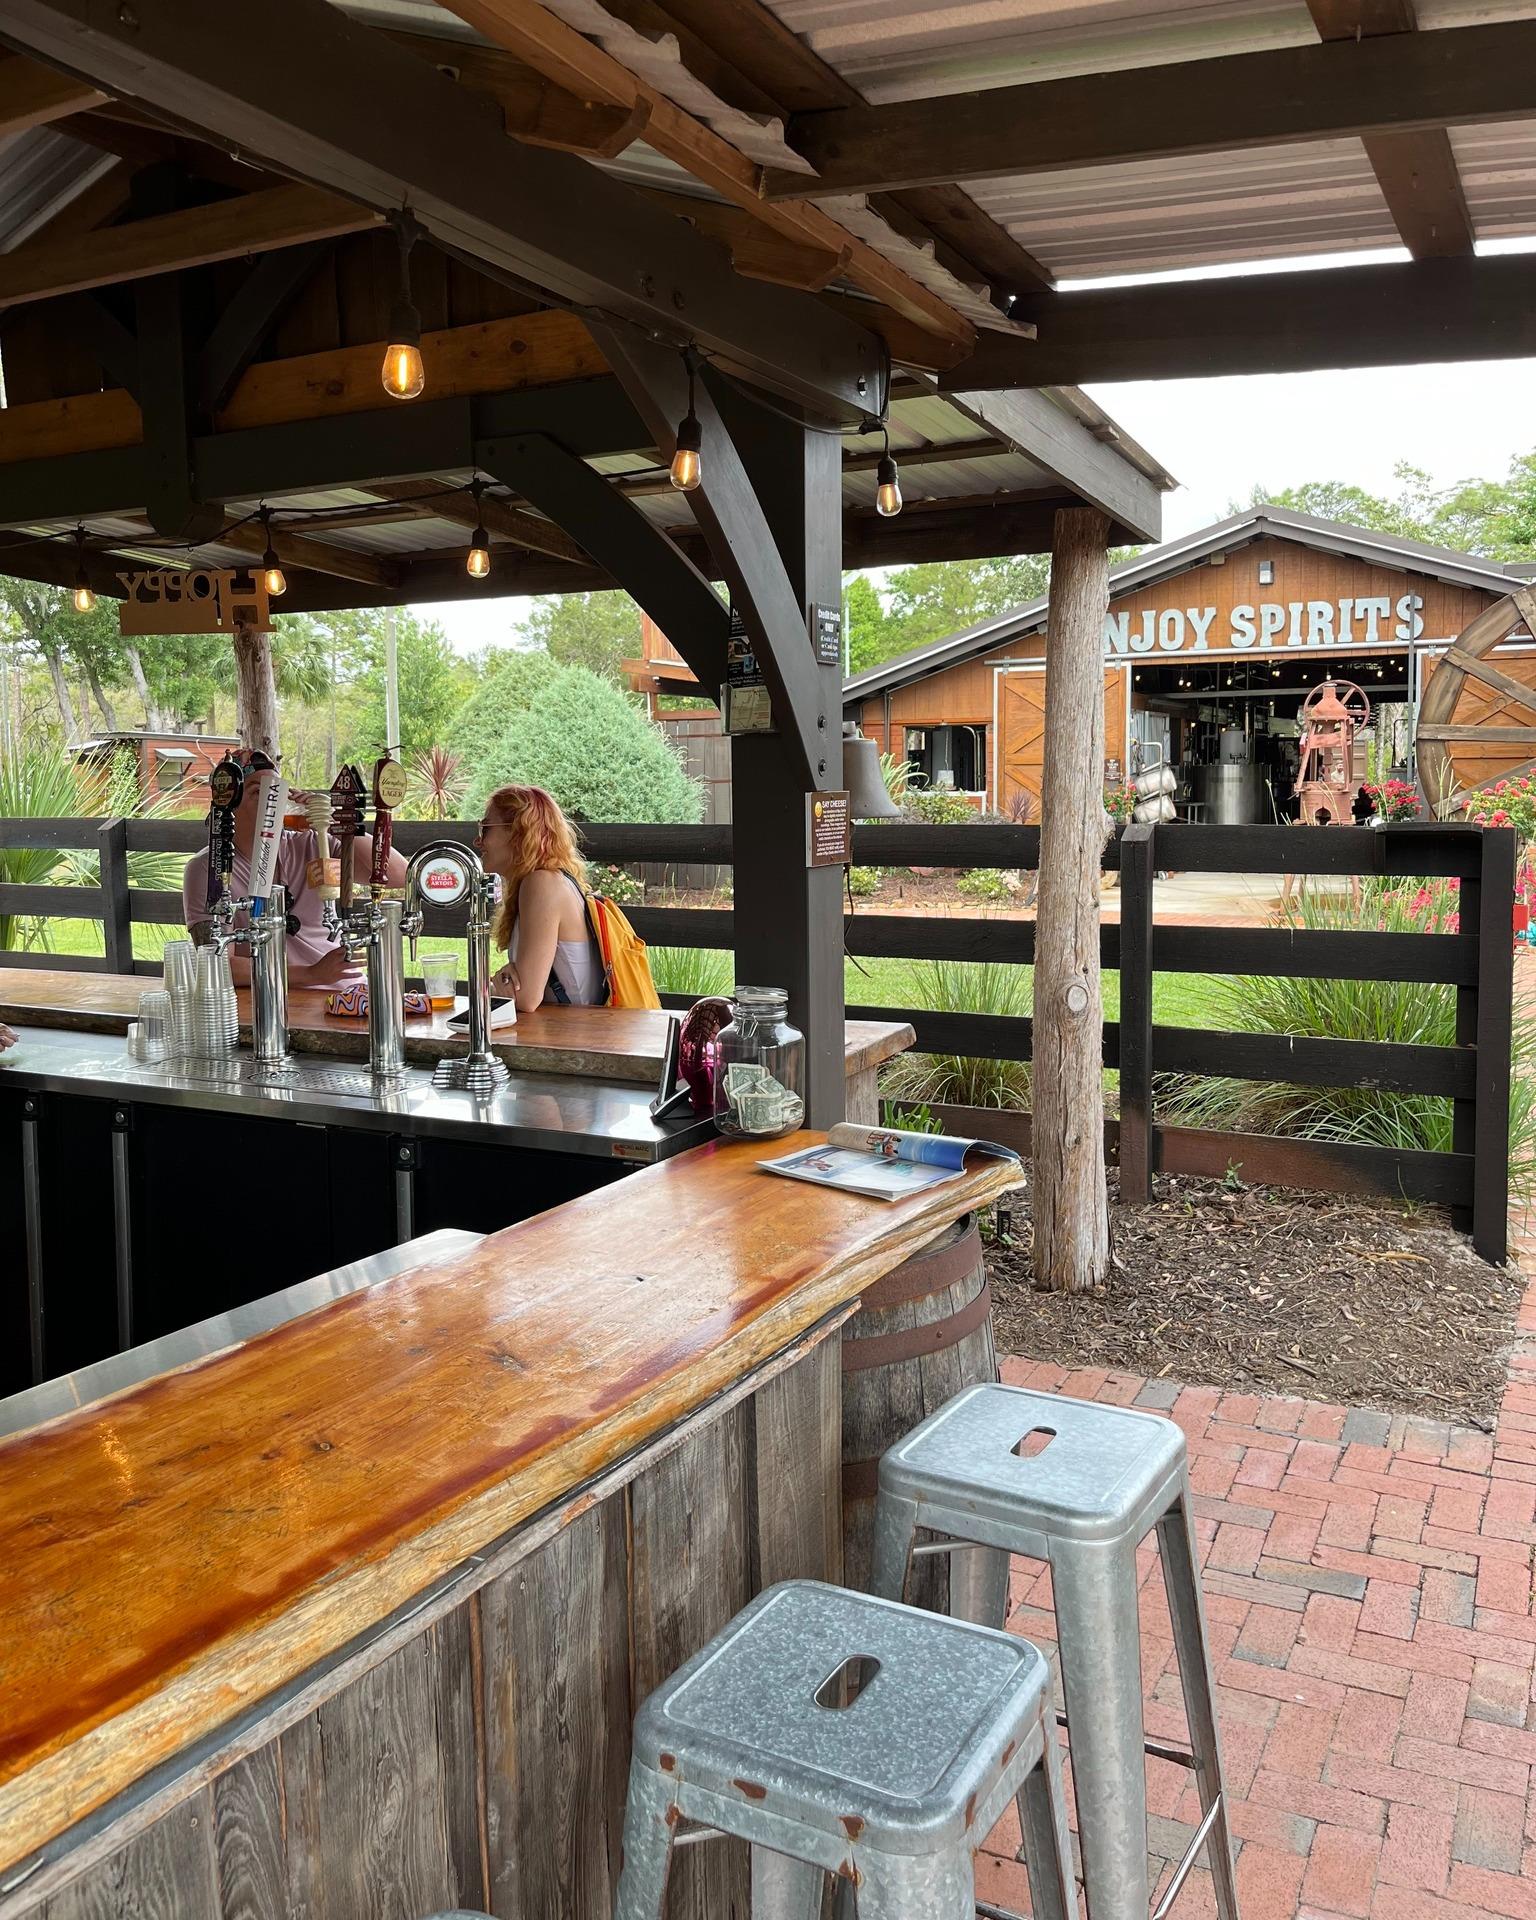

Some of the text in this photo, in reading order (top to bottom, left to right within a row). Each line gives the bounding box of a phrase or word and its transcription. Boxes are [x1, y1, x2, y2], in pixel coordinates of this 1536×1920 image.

[1104, 594, 1424, 654] NJOY SPIRITS
[263, 783, 281, 829] ULTRA
[337, 776, 351, 790] 48
